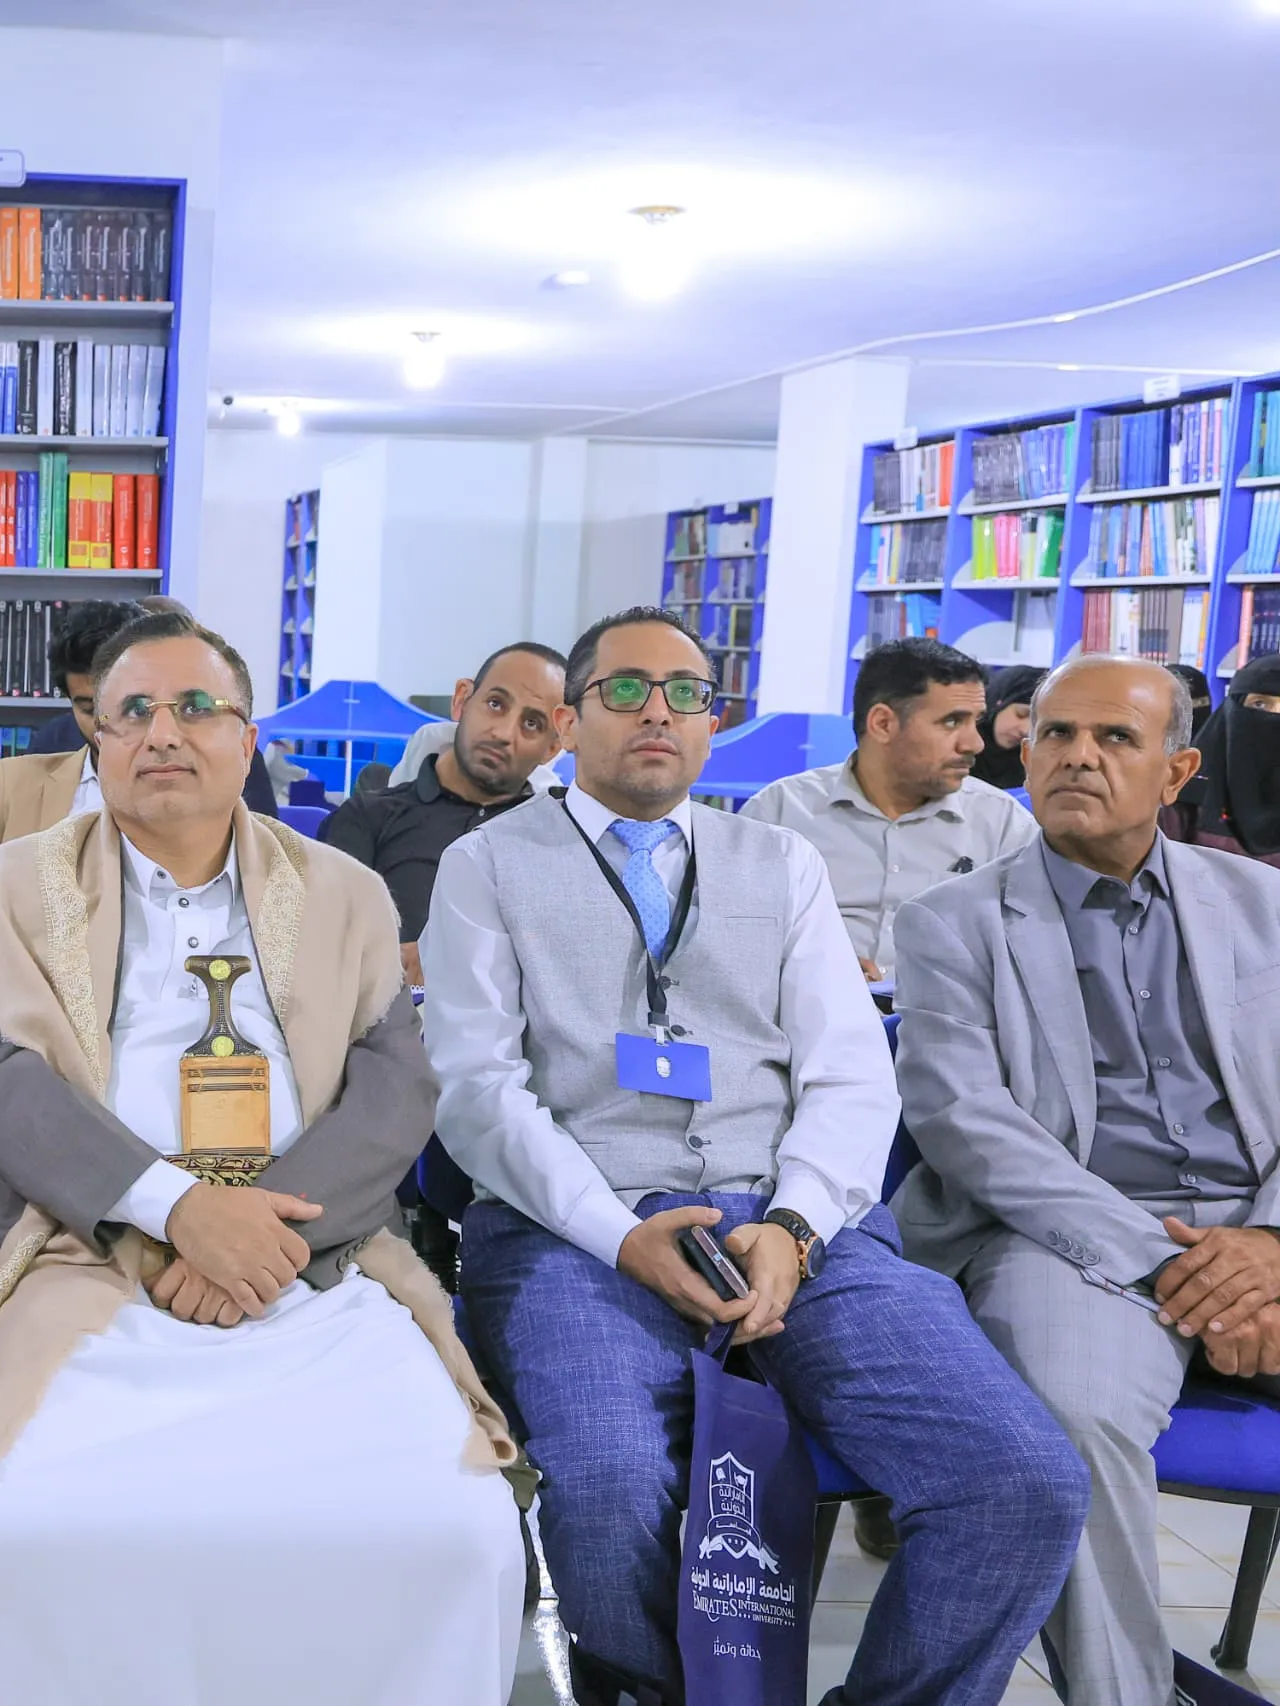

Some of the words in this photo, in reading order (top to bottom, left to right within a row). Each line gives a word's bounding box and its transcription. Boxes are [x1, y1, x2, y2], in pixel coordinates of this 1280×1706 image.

[759, 1580, 795, 1605] الجامعة
[693, 1590, 738, 1622] EMIRATES
[738, 1599, 796, 1619] INTERNATIONAL
[752, 1614, 784, 1626] UNIVERSITY
